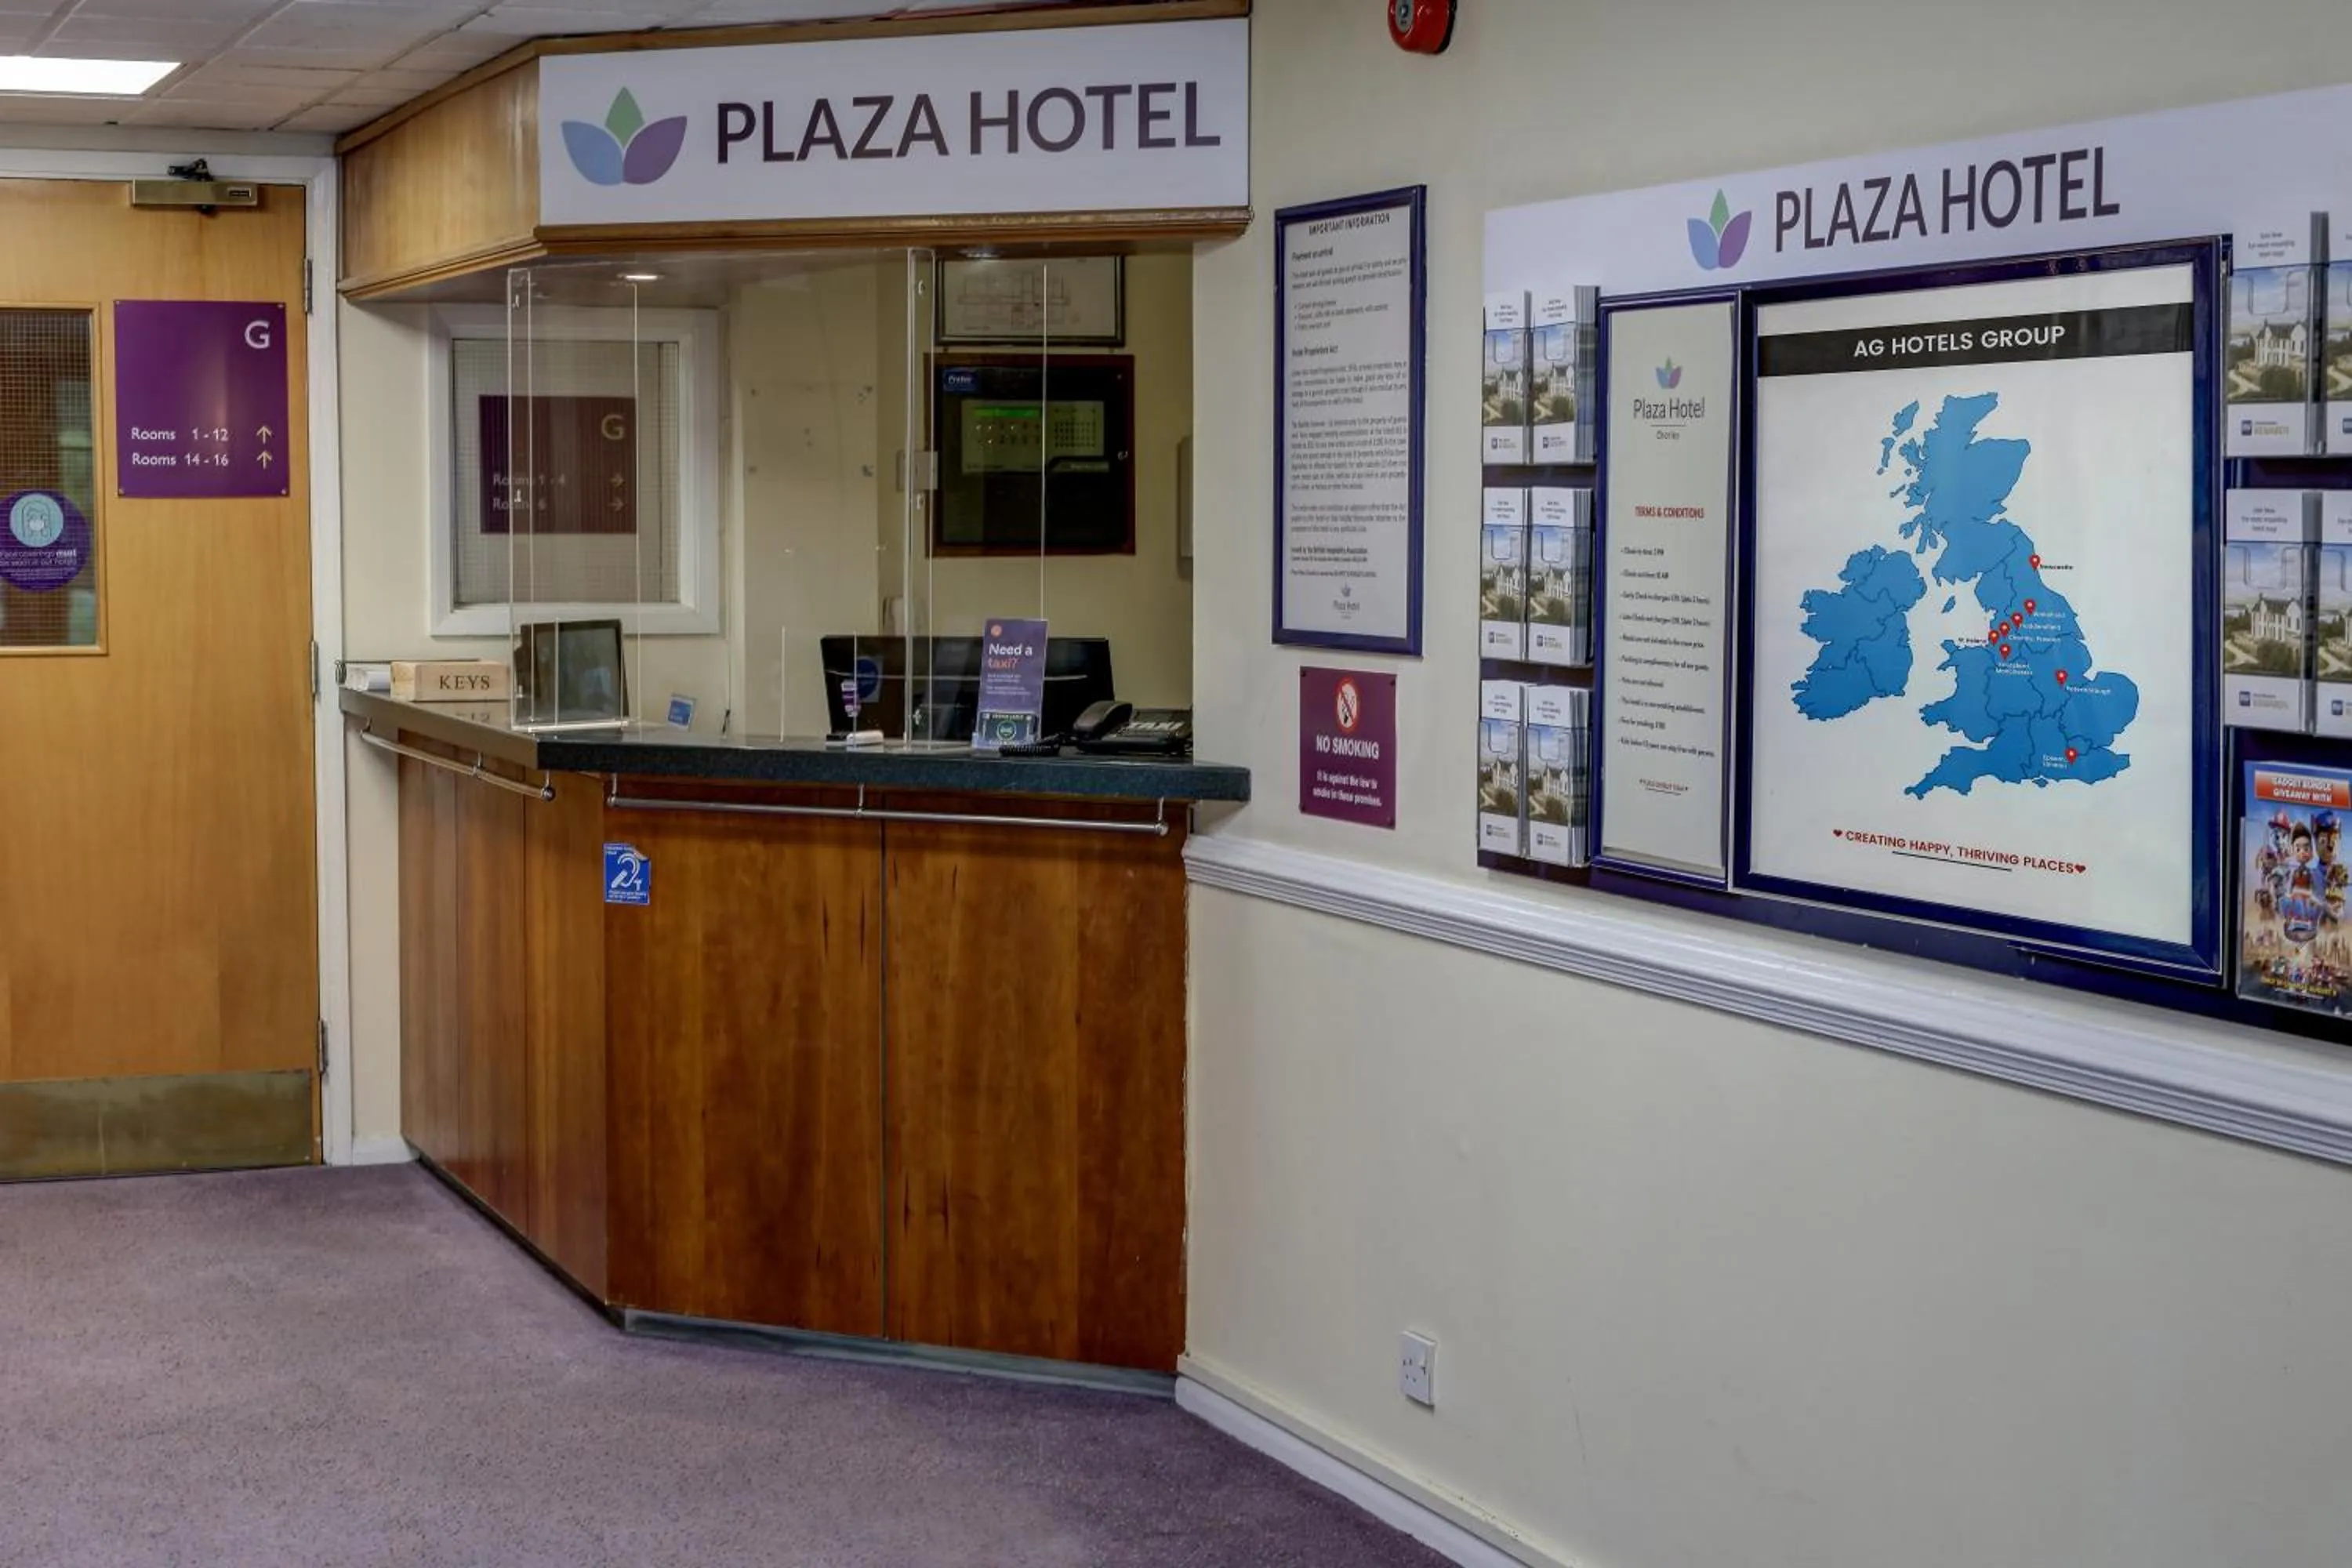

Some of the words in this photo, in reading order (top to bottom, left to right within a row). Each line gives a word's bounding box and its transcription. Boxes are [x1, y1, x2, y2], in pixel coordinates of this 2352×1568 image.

[716, 93, 950, 165] PLAZA
[969, 81, 1221, 154] HOTEL
[1774, 172, 1928, 252] PLAZA
[1940, 147, 2121, 234] HOTEL
[1308, 219, 1344, 236] IMPORTANT
[1345, 212, 1390, 231] INFORMATION
[243, 320, 271, 350] G
[1853, 338, 1884, 358] AG
[1892, 330, 1973, 355] HOTELS
[1980, 325, 2065, 349] GROUP
[1633, 398, 1666, 419] Plaza
[1668, 397, 1705, 419] Hotel
[131, 426, 176, 441] Rooms
[192, 428, 199, 440] 1
[212, 428, 229, 441] 12
[601, 413, 625, 441] G
[132, 452, 176, 466] Rooms
[184, 452, 201, 466] 14
[213, 452, 229, 466] 16
[1635, 506, 1656, 517] TERMS
[1664, 506, 1704, 520] CONDITIONS
[988, 643, 1022, 656] Need
[1025, 646, 1033, 656] a
[988, 656, 1019, 670] taxi?
[439, 674, 491, 691] KEYS
[1316, 735, 1330, 753] NO
[1332, 737, 1380, 760] SMOKING
[1846, 830, 1907, 849] CREATING
[1909, 840, 1954, 858] HAPPY,
[1957, 846, 2020, 866] THRIVING
[2024, 857, 2075, 874] PLACES
